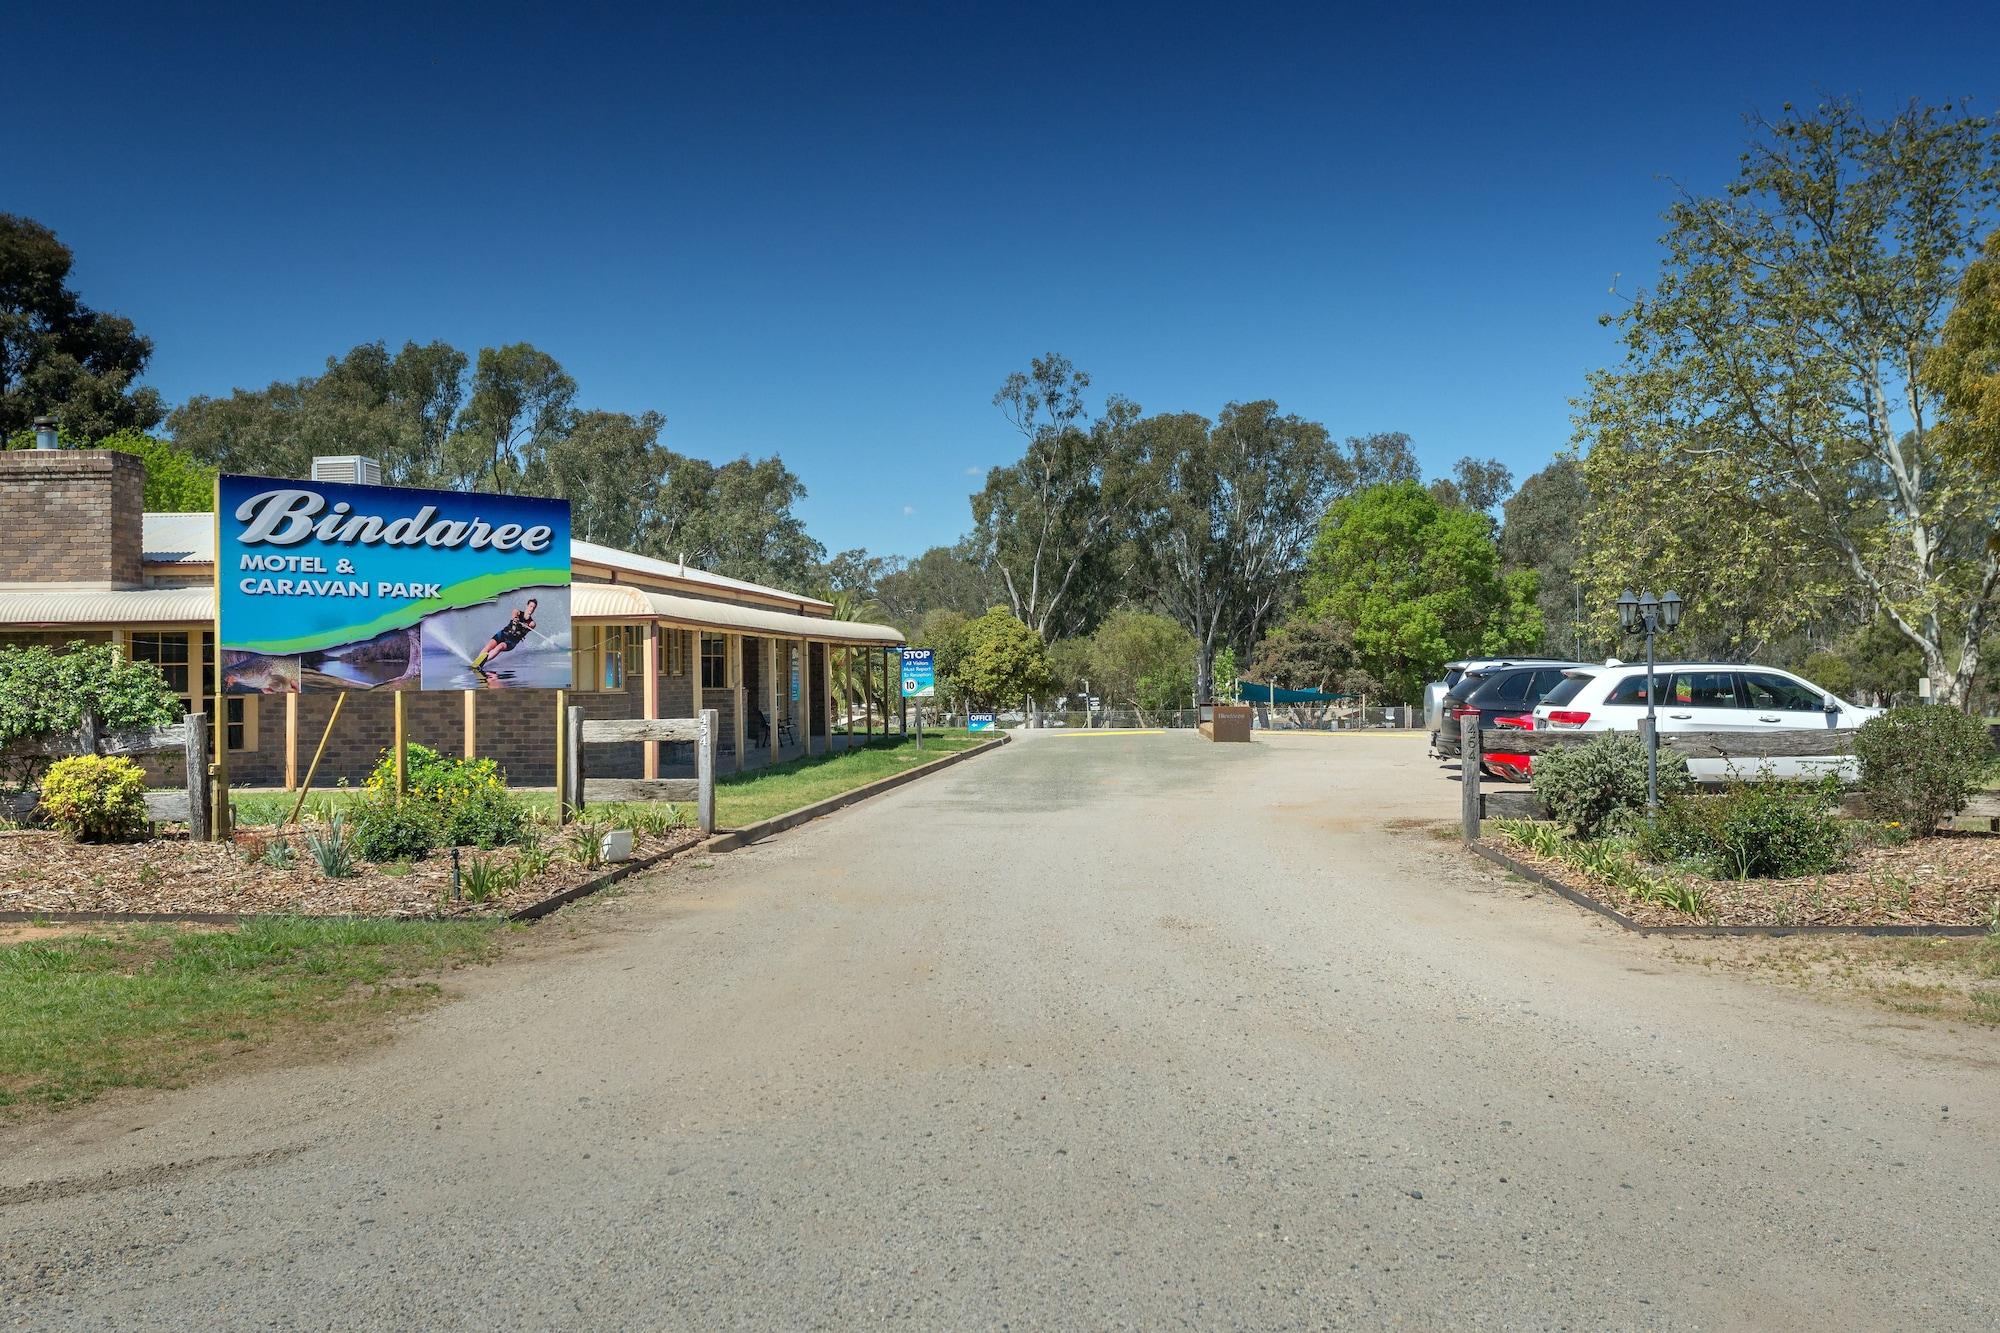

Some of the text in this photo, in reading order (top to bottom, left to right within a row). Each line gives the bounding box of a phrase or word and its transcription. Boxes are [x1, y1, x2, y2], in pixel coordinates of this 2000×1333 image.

[235, 489, 552, 551] Bindaree
[240, 555, 355, 574] MOTEL &
[239, 578, 442, 599] CARAVAN PARK
[903, 651, 930, 659] STOP
[906, 681, 915, 690] 10
[699, 714, 707, 745] 454
